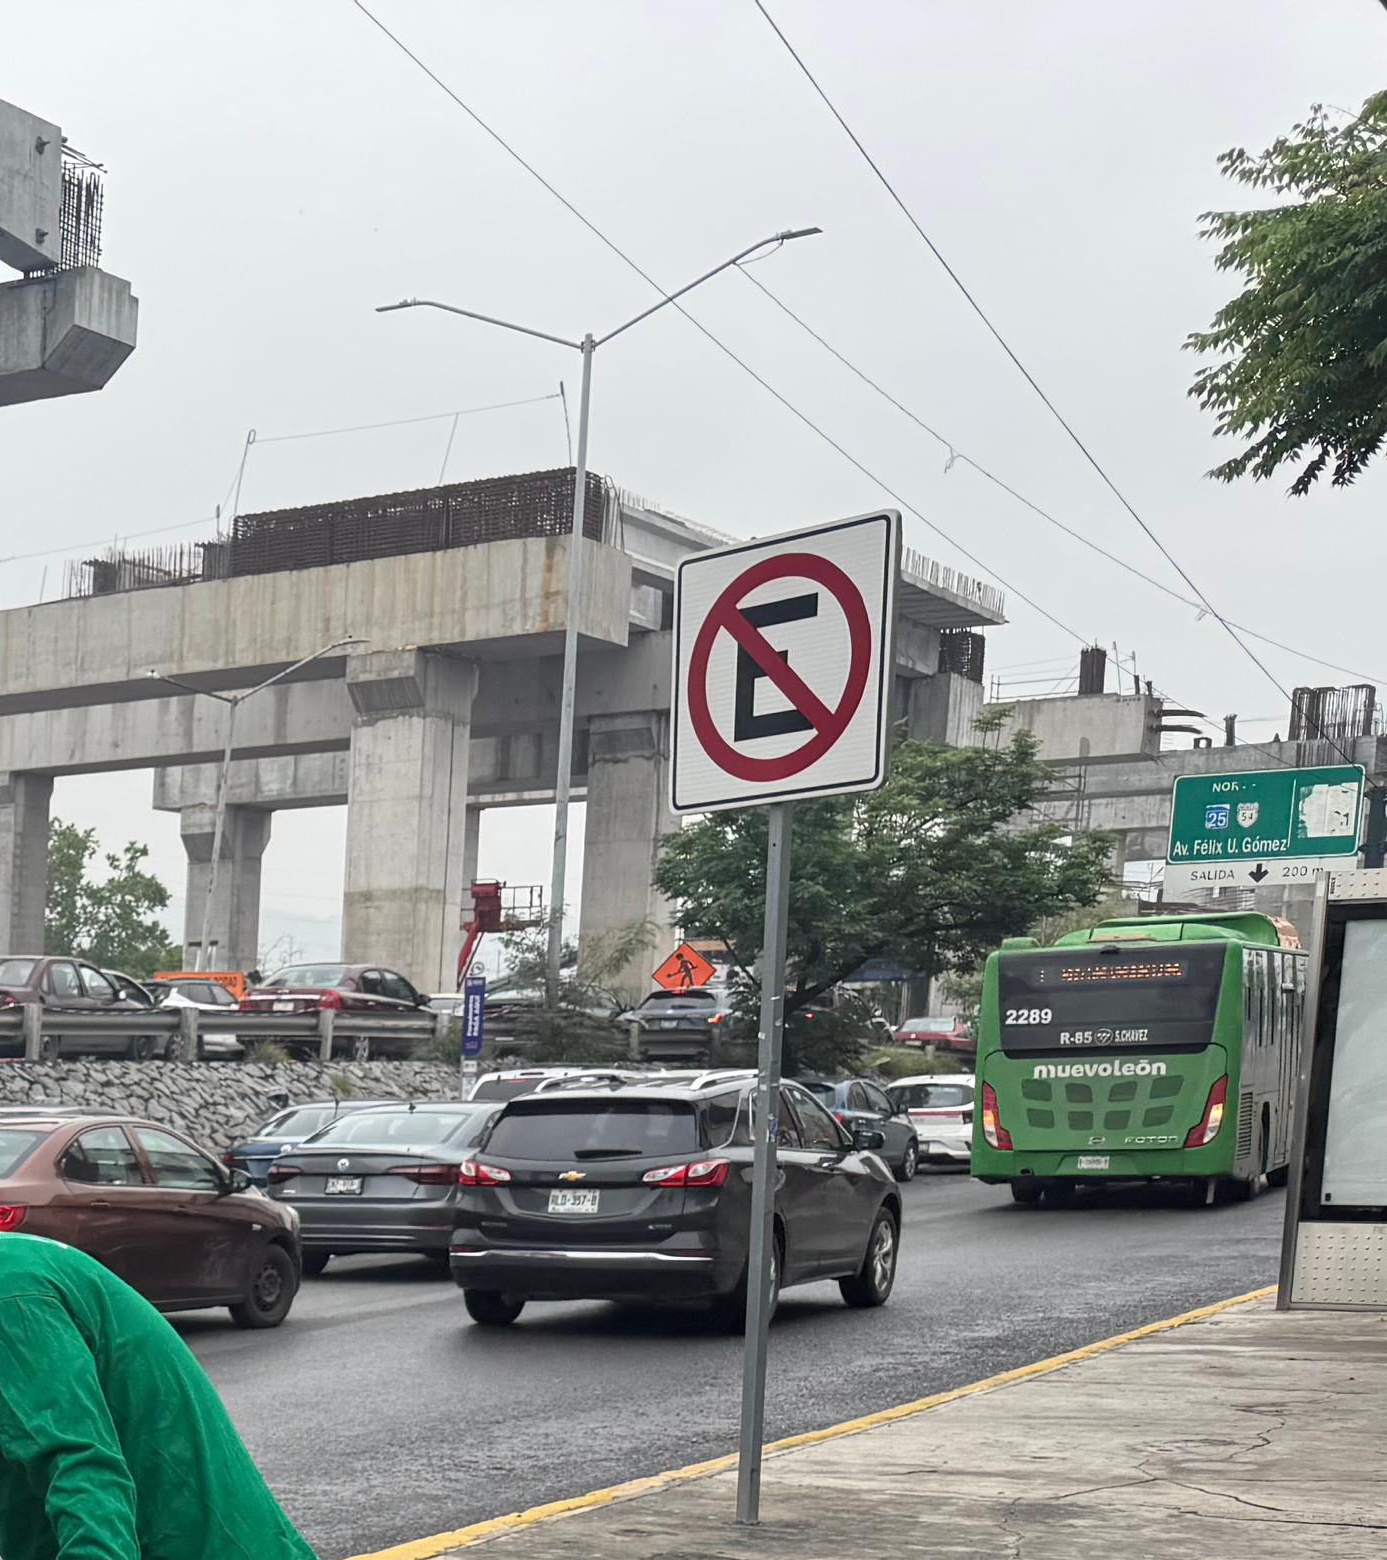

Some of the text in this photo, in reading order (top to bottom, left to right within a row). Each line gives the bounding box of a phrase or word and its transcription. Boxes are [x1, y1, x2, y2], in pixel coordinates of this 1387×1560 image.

[734, 593, 819, 742] E
[1212, 782, 1257, 793] NOR
[1208, 812, 1226, 827] 25
[1241, 812, 1254, 822] 54
[1173, 836, 1287, 856] Av. Félix U. Gómez
[1190, 870, 1235, 881] SALIDA
[1282, 866, 1308, 877] 200
[1005, 1008, 1052, 1025] 2289
[1060, 1031, 1092, 1044] R-85
